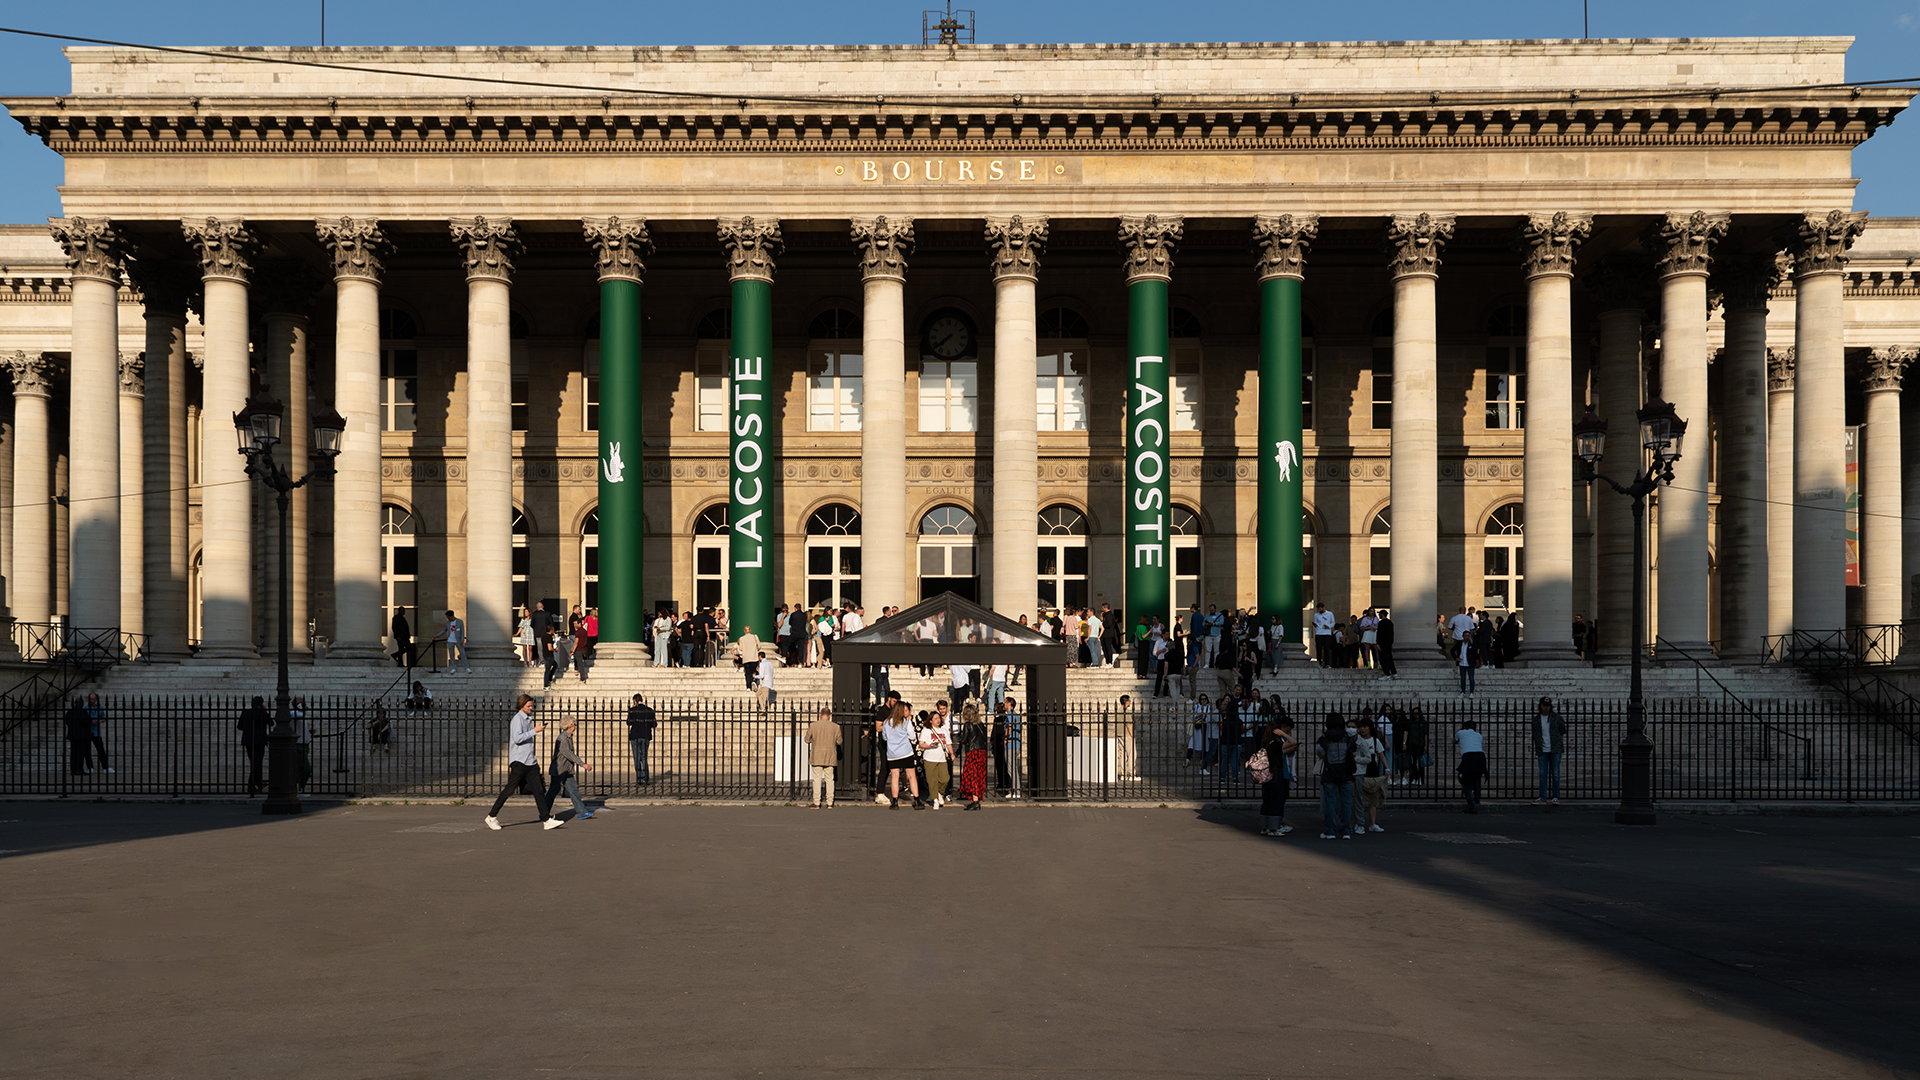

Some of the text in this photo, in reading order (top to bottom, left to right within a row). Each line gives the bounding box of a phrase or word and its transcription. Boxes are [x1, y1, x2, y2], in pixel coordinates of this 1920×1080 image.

[862, 160, 1036, 181] BOURSE
[735, 356, 763, 568] LACOSTE
[1134, 355, 1163, 568] LACOSTE
